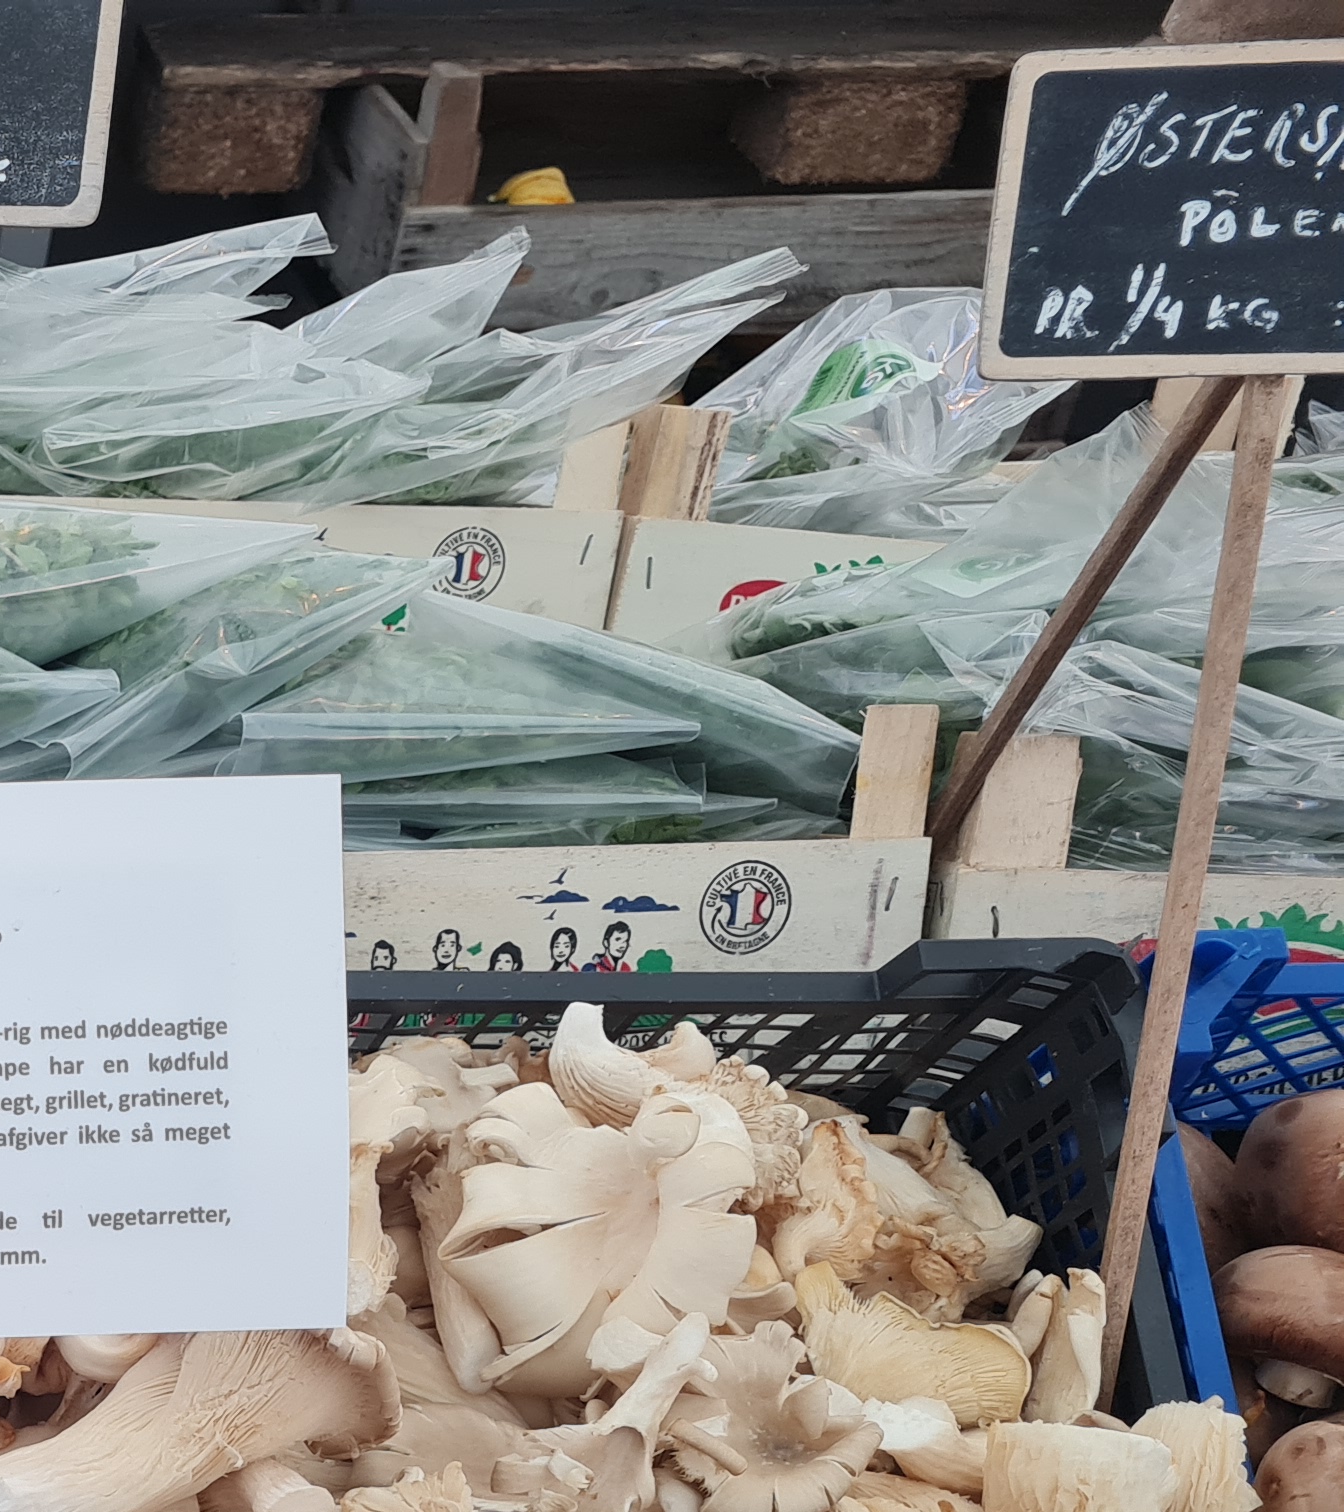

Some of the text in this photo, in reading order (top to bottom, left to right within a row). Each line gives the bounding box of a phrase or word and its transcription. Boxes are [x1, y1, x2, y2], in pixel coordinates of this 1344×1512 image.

[1205, 295, 1280, 333] KG
[706, 866, 787, 908] CULTIVÉ EN FRANCE
[39, 1019, 87, 1041] med
[96, 1016, 228, 1041] nøddeagtige
[49, 1055, 85, 1076] har
[102, 1058, 129, 1074] en
[148, 1050, 229, 1075] kødfuld
[44, 1089, 114, 1115] grillet,
[118, 1087, 230, 1113] gratineret,
[78, 1123, 121, 1145] ikke
[130, 1121, 154, 1143] så
[164, 1122, 232, 1146] meget
[41, 1208, 63, 1230] til
[87, 1205, 231, 1231] vegetarretter,
[0, 1249, 47, 1266] mm.
